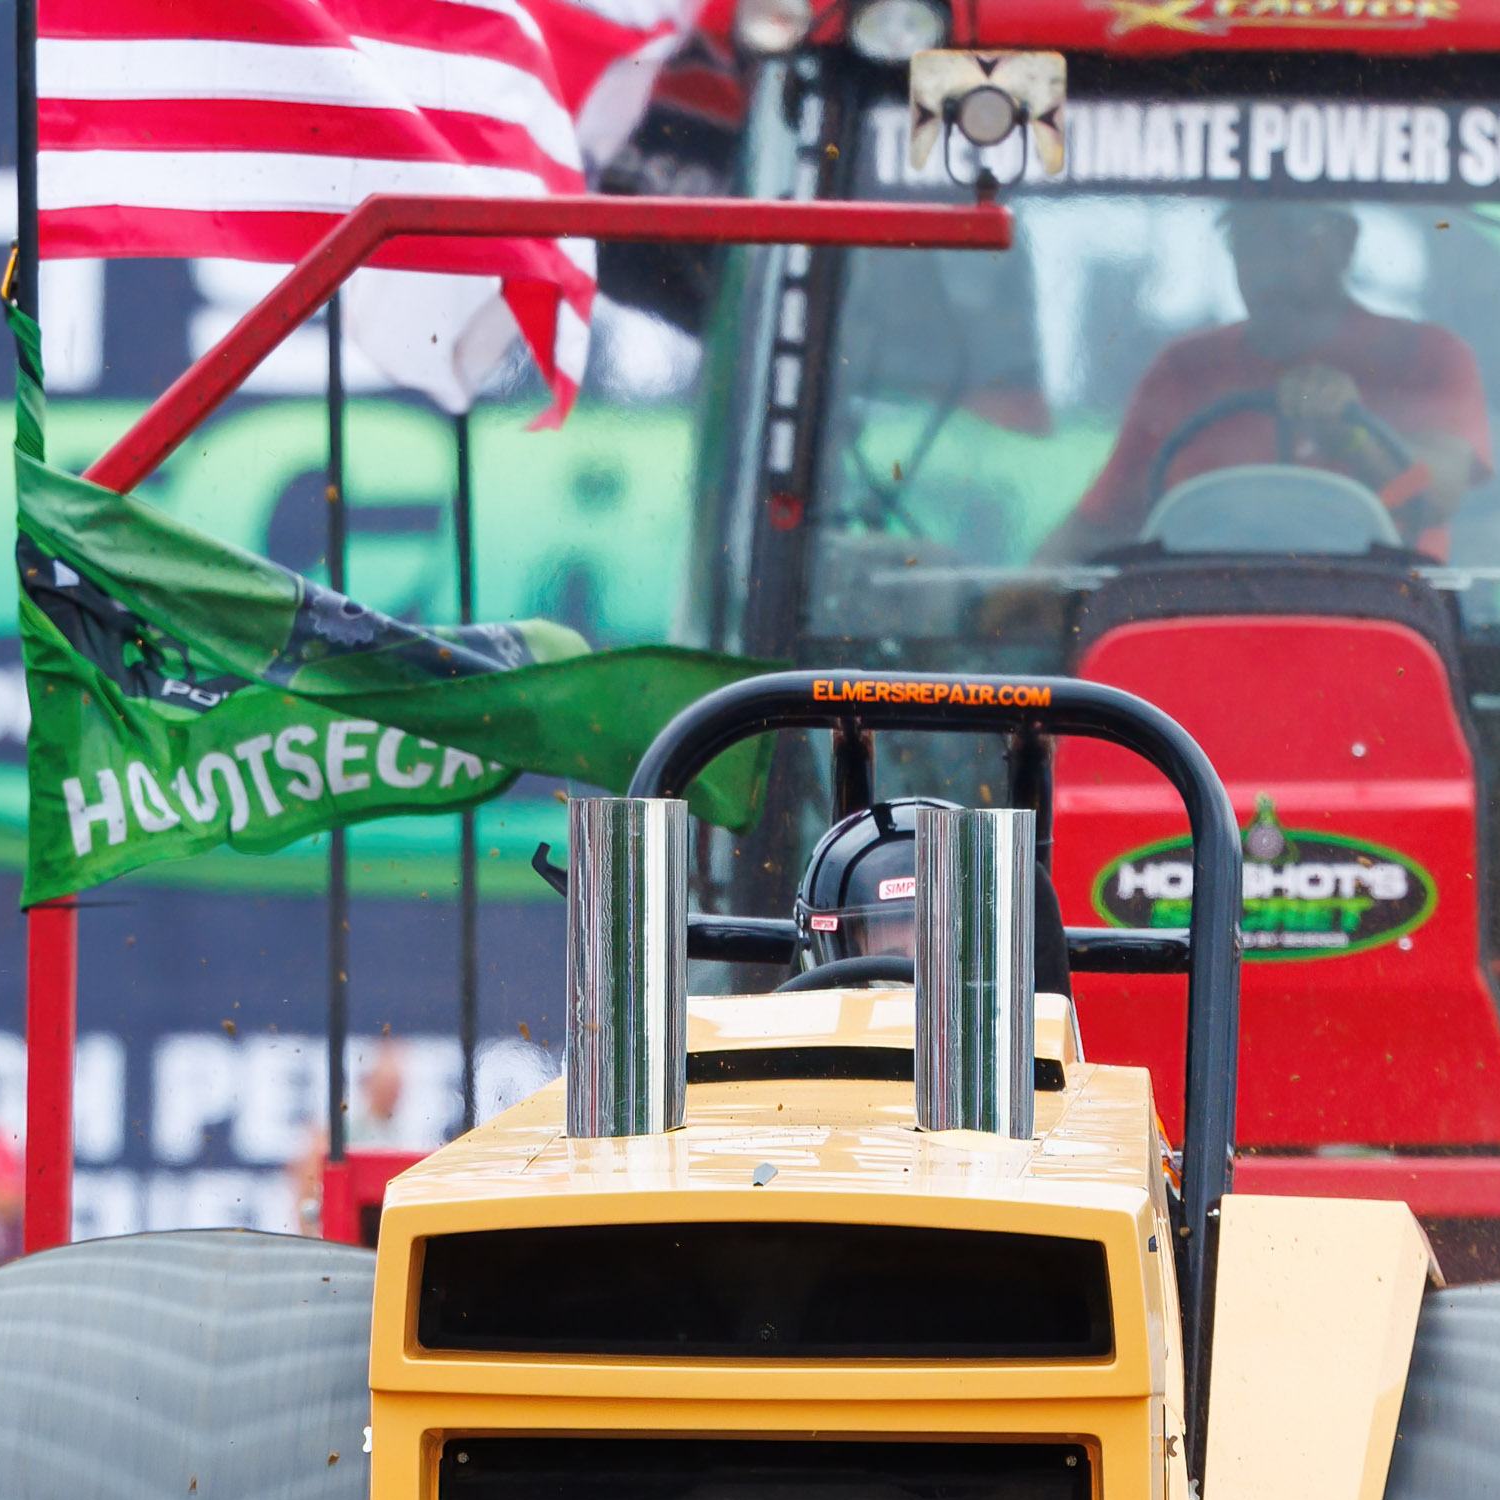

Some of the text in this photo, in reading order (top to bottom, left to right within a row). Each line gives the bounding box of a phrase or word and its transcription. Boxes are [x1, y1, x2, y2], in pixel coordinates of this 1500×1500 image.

[1249, 104, 1450, 185] POWER
[813, 680, 1051, 707] ELMERSREPAIR.COM
[1117, 862, 1194, 899] HO
